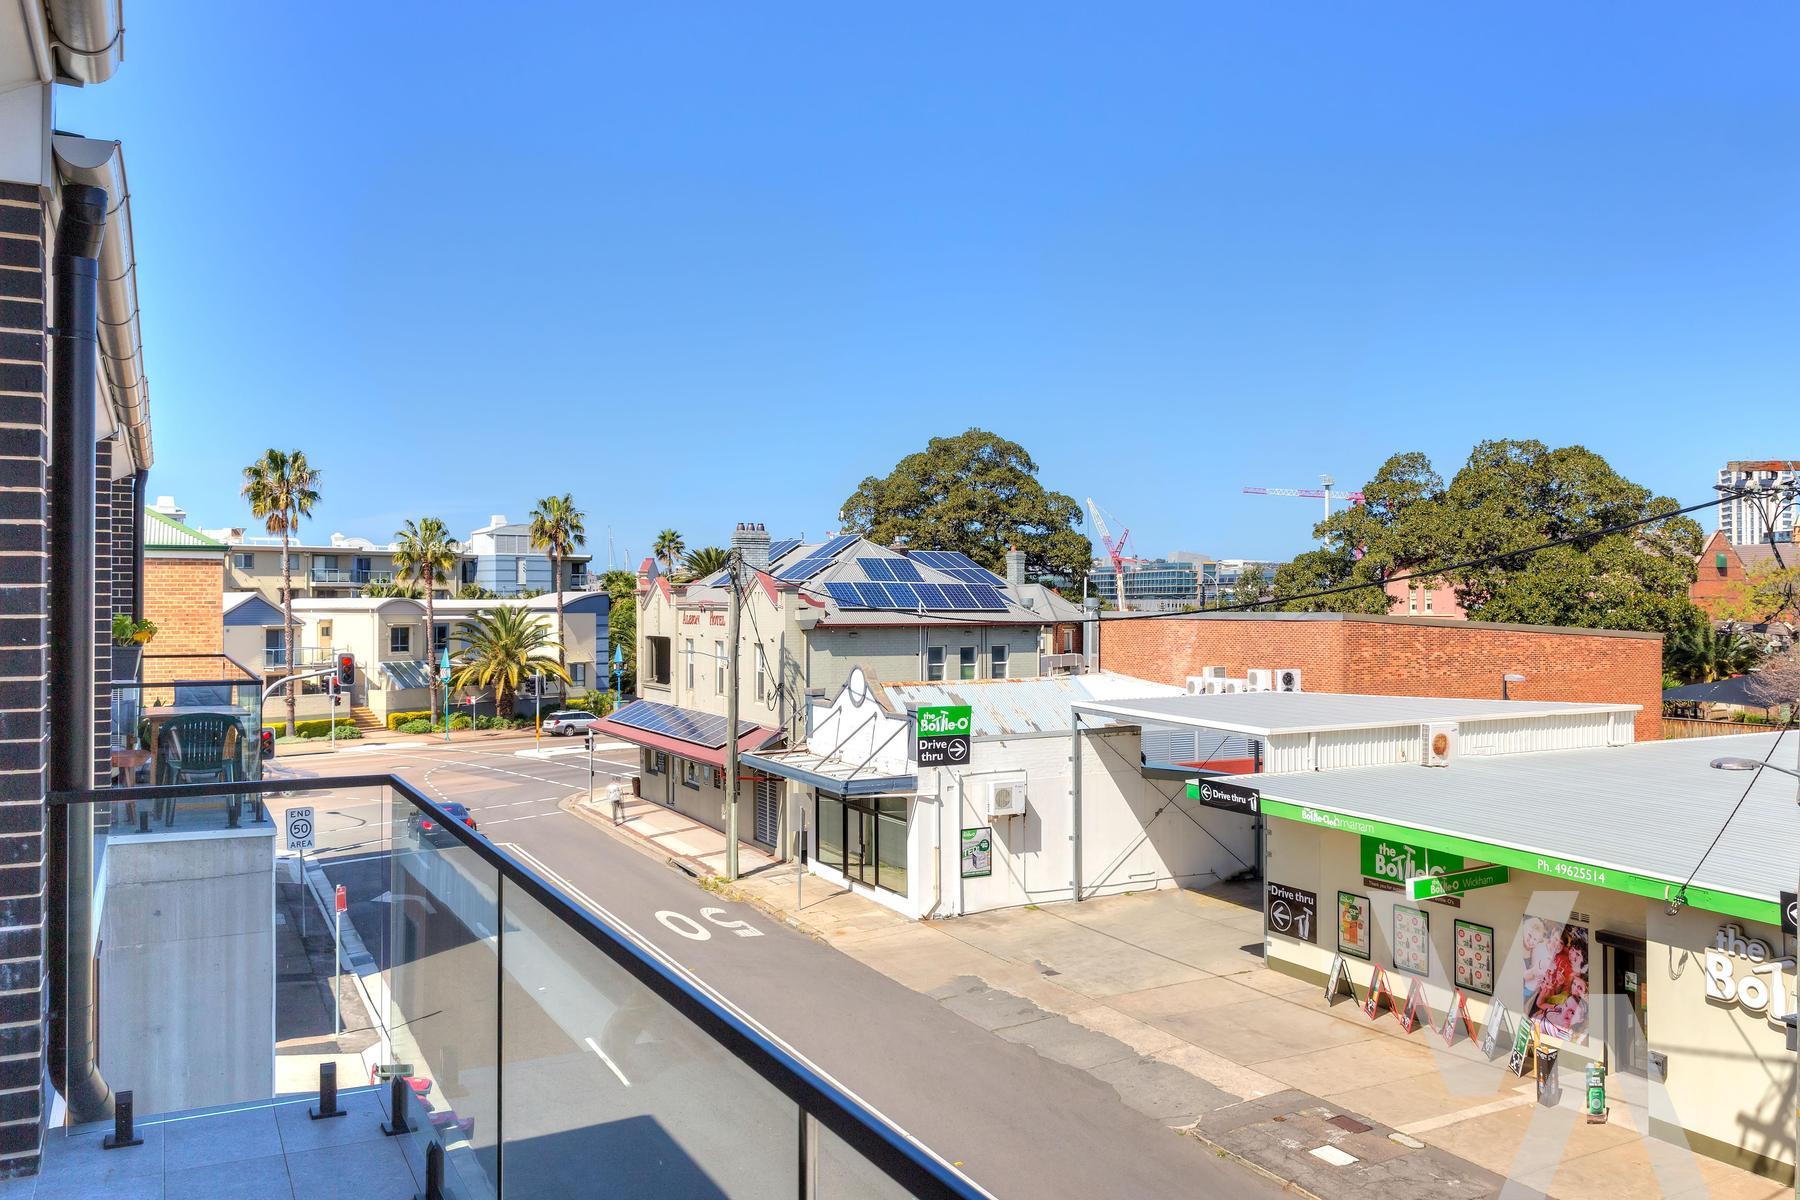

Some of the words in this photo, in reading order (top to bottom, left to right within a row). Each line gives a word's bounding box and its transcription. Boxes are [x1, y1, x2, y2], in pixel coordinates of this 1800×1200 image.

[923, 712, 936, 720] the
[919, 739, 948, 750] Drive
[921, 751, 944, 762] thru
[1212, 789, 1231, 802] Drive
[1231, 793, 1247, 804] thru
[290, 809, 311, 818] END
[293, 823, 308, 835] 50
[290, 840, 313, 849] AREA
[1379, 843, 1396, 857] the
[1537, 858, 1552, 873] Ph.
[1554, 863, 1606, 883] 49625514
[1462, 876, 1494, 888] Wickham
[1271, 884, 1294, 900] Drive
[1295, 891, 1314, 906] thru
[1716, 926, 1766, 963] the
